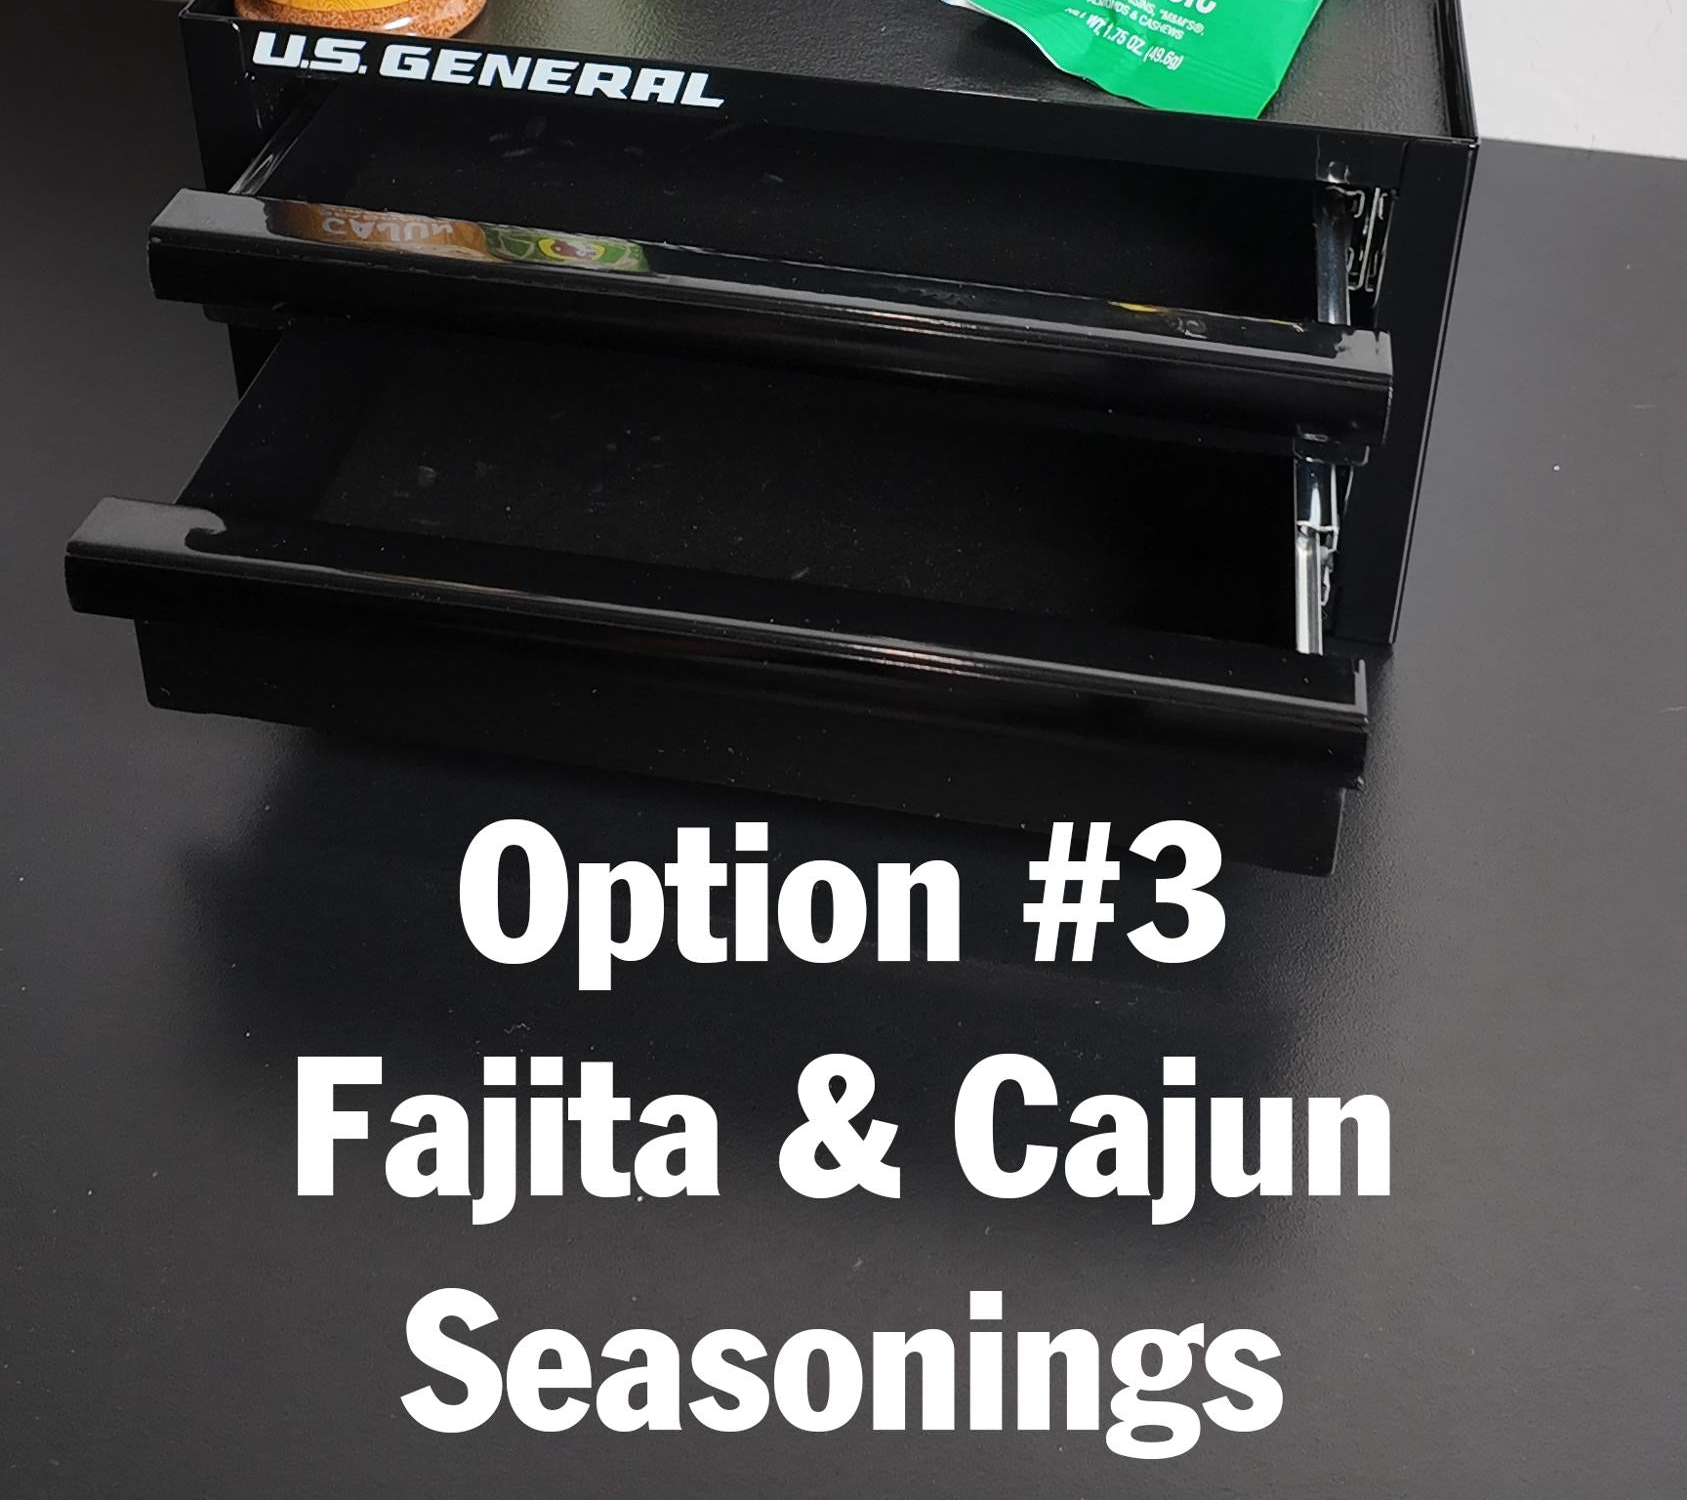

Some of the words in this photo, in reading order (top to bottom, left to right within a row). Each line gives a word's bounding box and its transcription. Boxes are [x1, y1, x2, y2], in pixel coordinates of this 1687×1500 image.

[1102, 22, 1130, 45] 1.75
[1143, 45, 1184, 71] (49.6g)
[1129, 10, 1138, 21] &
[1138, 15, 1185, 40] CASHEWS
[252, 31, 368, 74] U.S.
[379, 44, 725, 109] GENERAL
